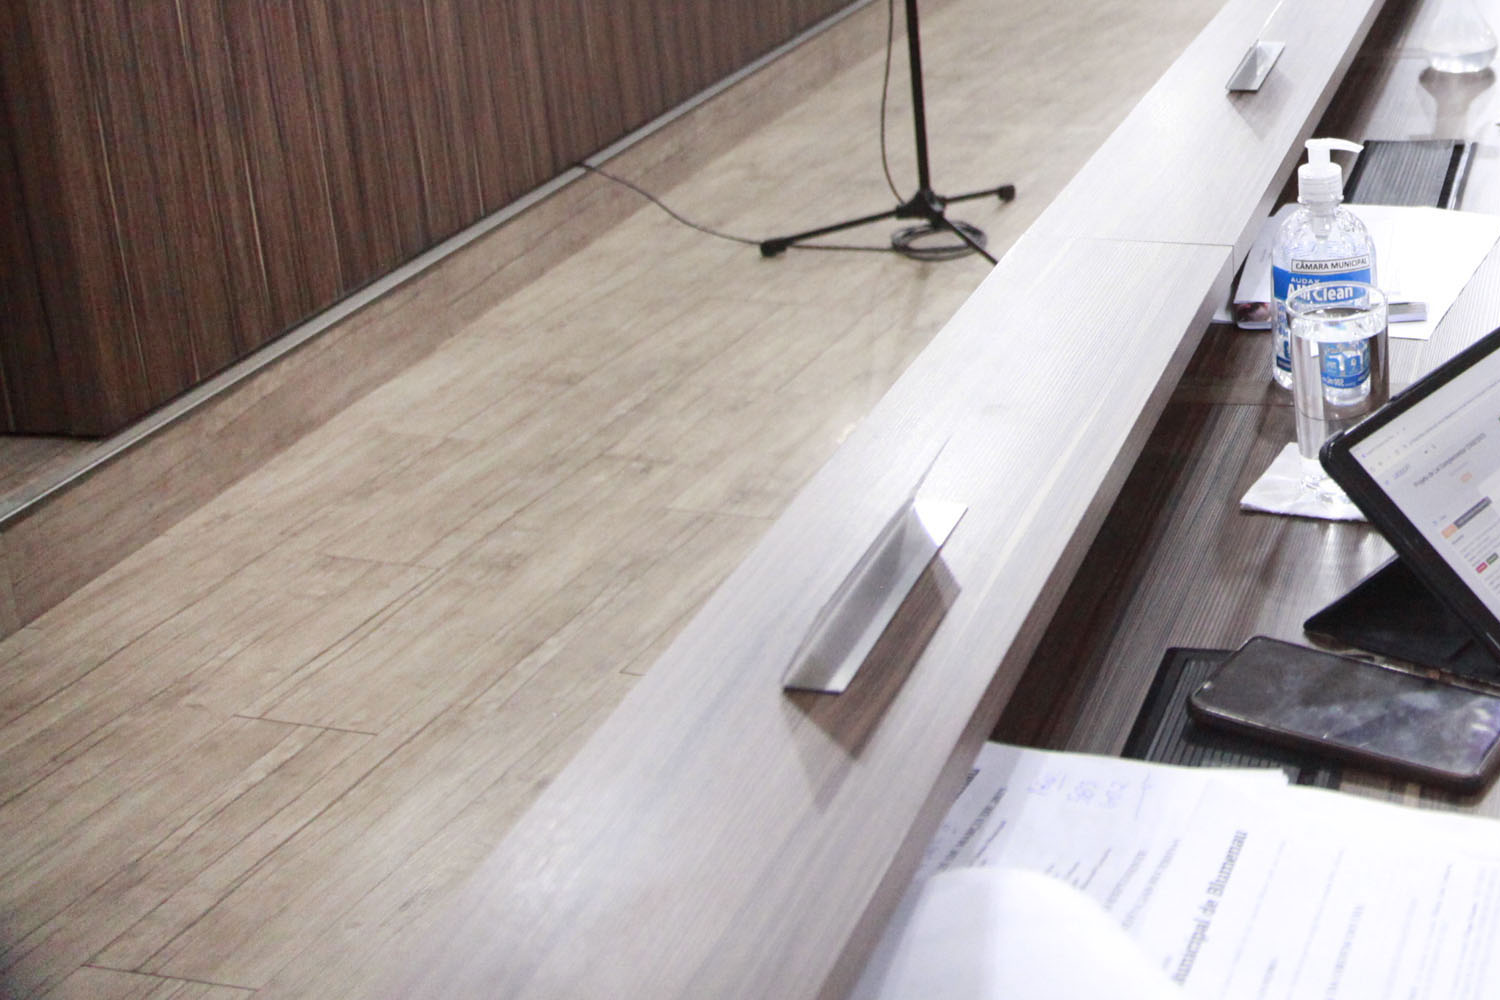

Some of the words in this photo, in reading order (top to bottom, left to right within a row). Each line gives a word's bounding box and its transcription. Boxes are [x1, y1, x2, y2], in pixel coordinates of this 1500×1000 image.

[1295, 260, 1329, 270] CÂMARA
[1330, 257, 1368, 269] MUNICIPAL
[1206, 830, 1248, 897] Blumenau
